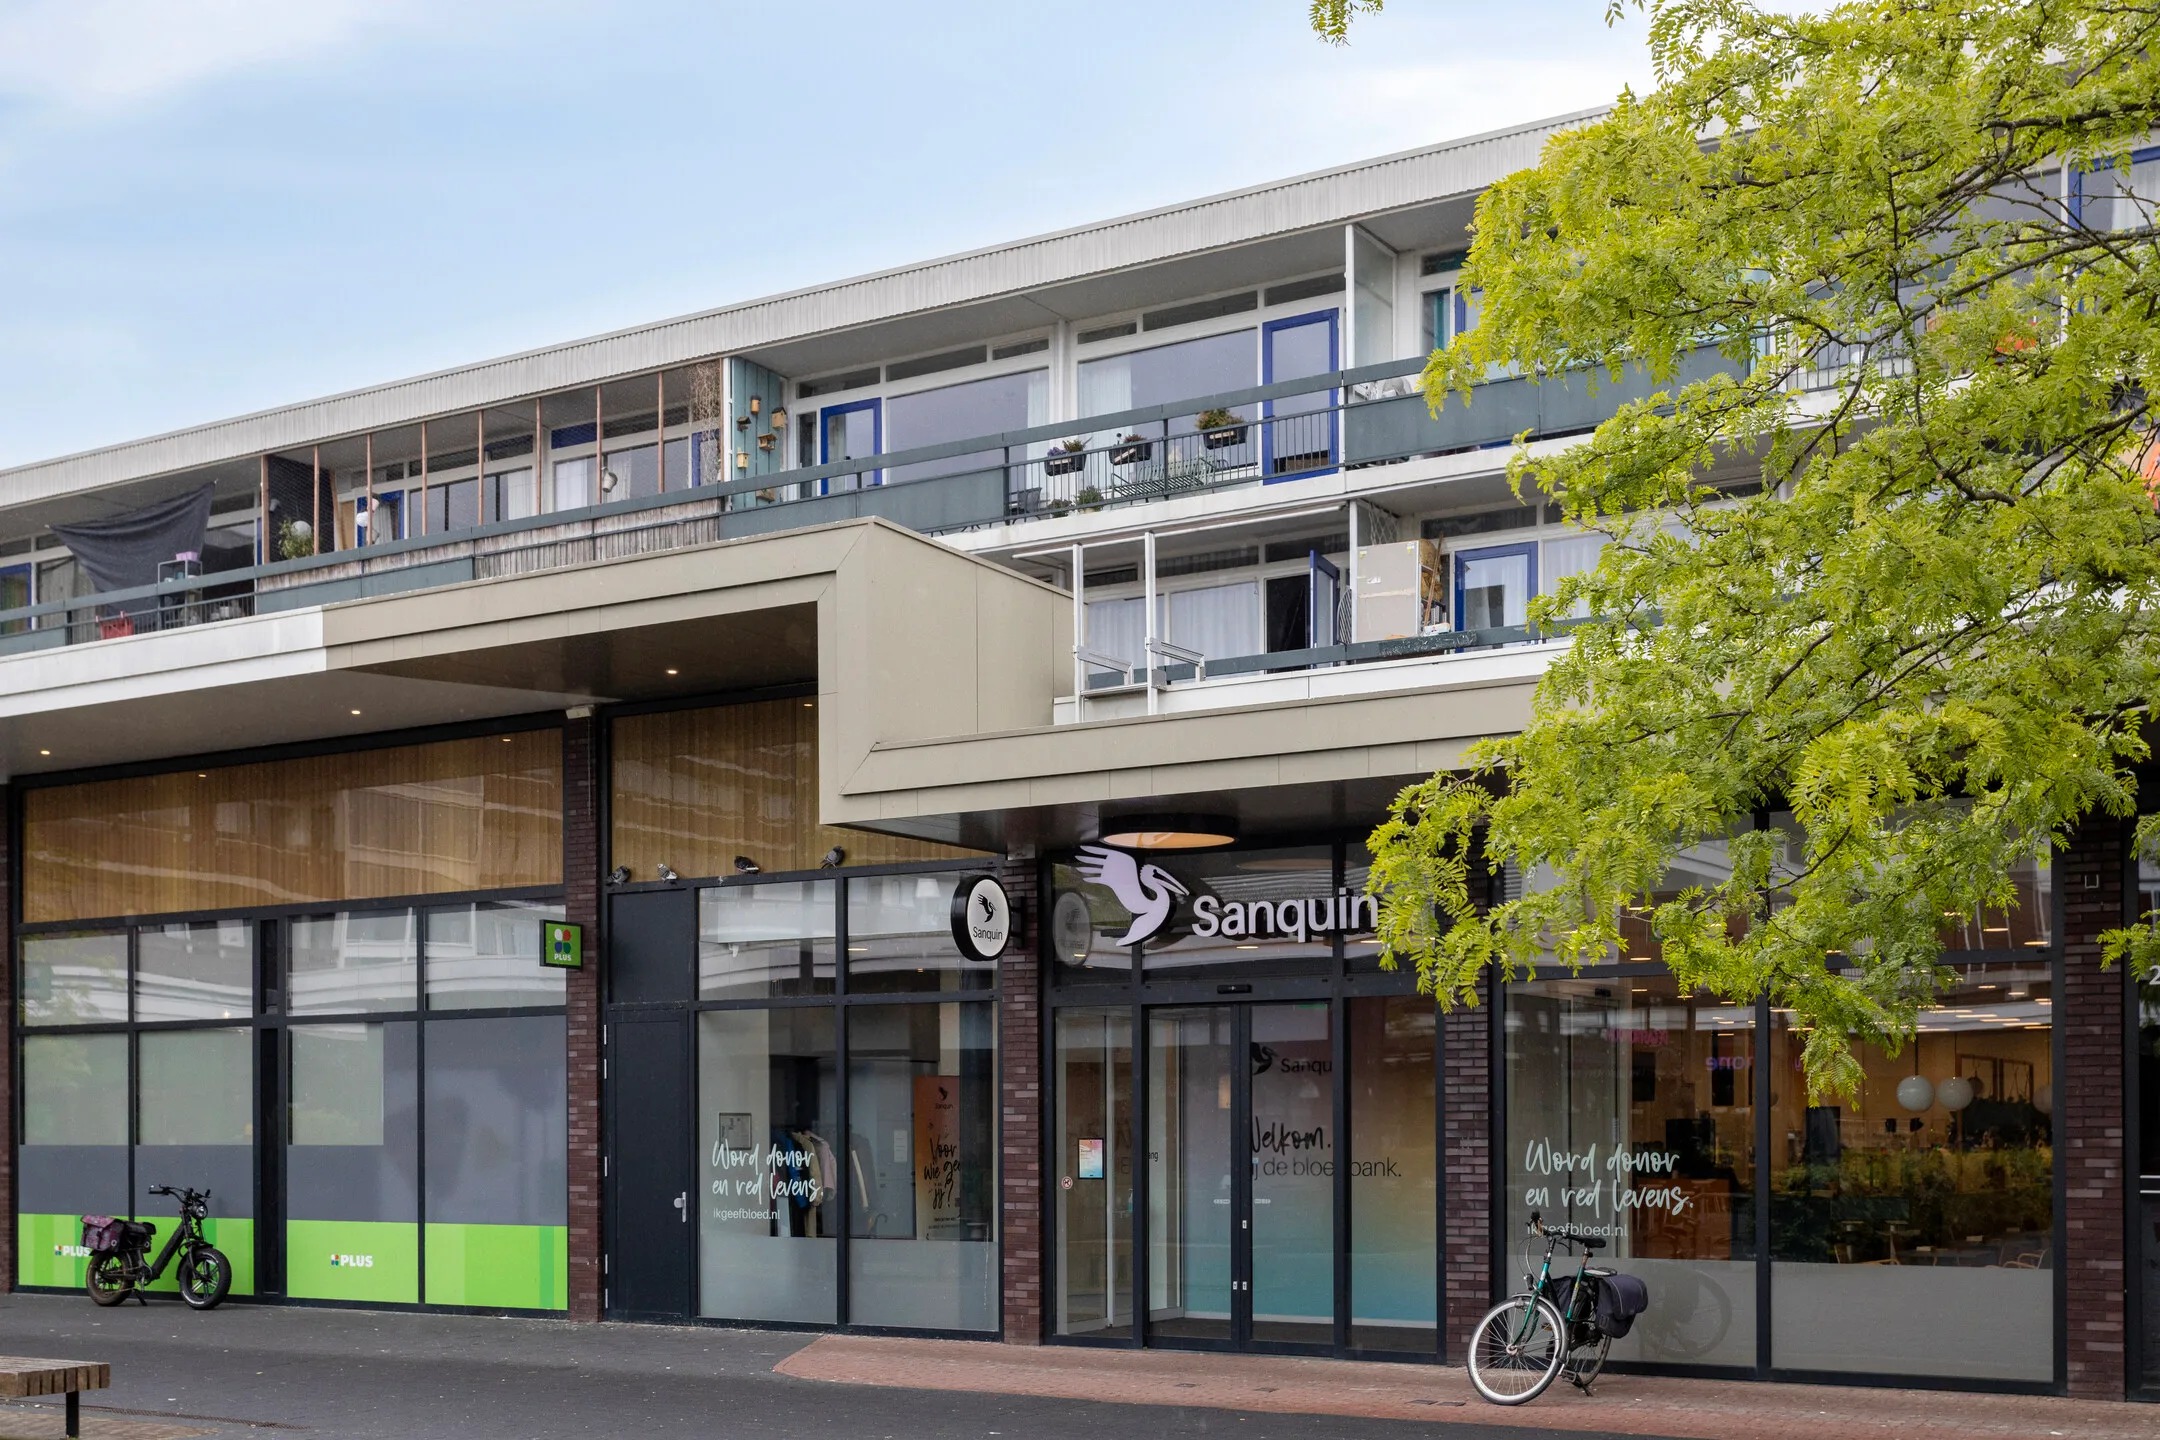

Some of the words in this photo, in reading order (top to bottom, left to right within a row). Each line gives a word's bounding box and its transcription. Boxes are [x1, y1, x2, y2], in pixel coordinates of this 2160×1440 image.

[1191, 887, 1379, 943] Sanquin
[973, 926, 1003, 942] Sanquin
[554, 953, 572, 961] PLUS
[1280, 1058, 1333, 1076] Sanqu
[712, 1139, 759, 1175] Word
[766, 1143, 814, 1175] donor
[930, 1134, 957, 1163] Voor
[1263, 1157, 1288, 1176] de
[1525, 1137, 1596, 1182] Word
[1606, 1143, 1680, 1182] donor
[712, 1179, 729, 1196] en
[736, 1173, 763, 1205] red
[770, 1172, 824, 1202] levens.
[1525, 1187, 1550, 1208] en
[1561, 1179, 1601, 1218] red
[1612, 1179, 1694, 1216] levens.
[713, 1208, 781, 1220] ikgeefbloed.nl
[62, 1245, 92, 1257] PLUS
[340, 1254, 374, 1267] PLUS
